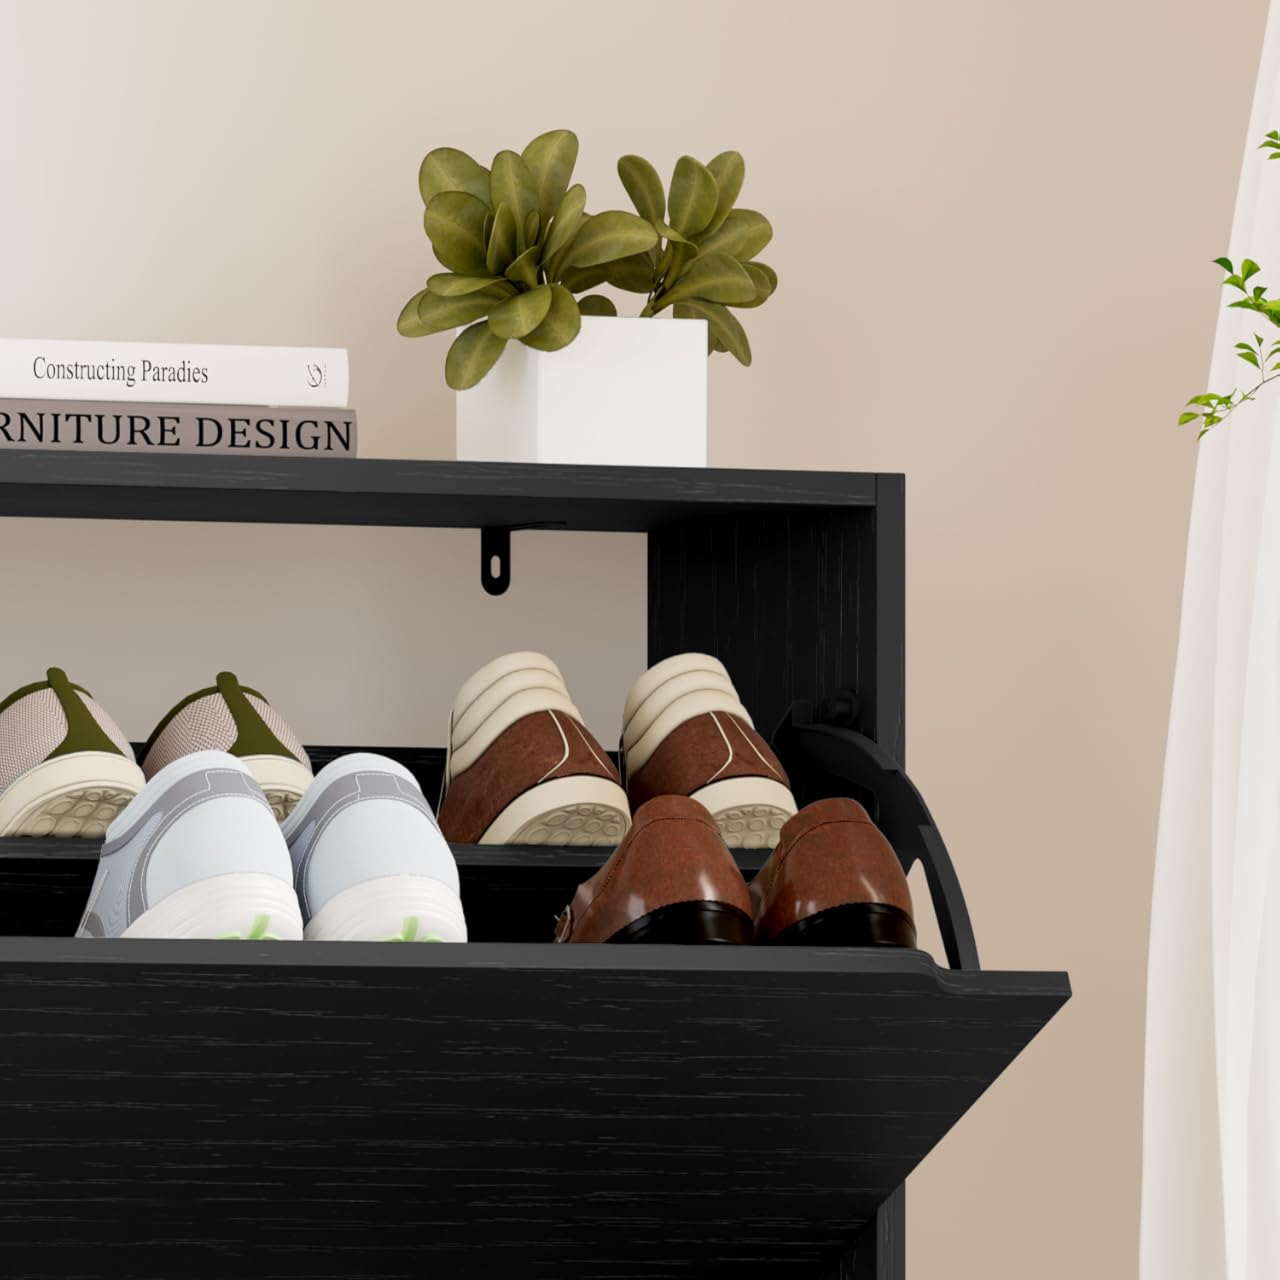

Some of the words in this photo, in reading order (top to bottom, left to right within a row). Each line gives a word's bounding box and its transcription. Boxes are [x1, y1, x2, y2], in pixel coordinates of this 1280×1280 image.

[33, 356, 136, 388] Constructing
[141, 359, 209, 383] Paradies
[195, 417, 353, 451] DESIGN
